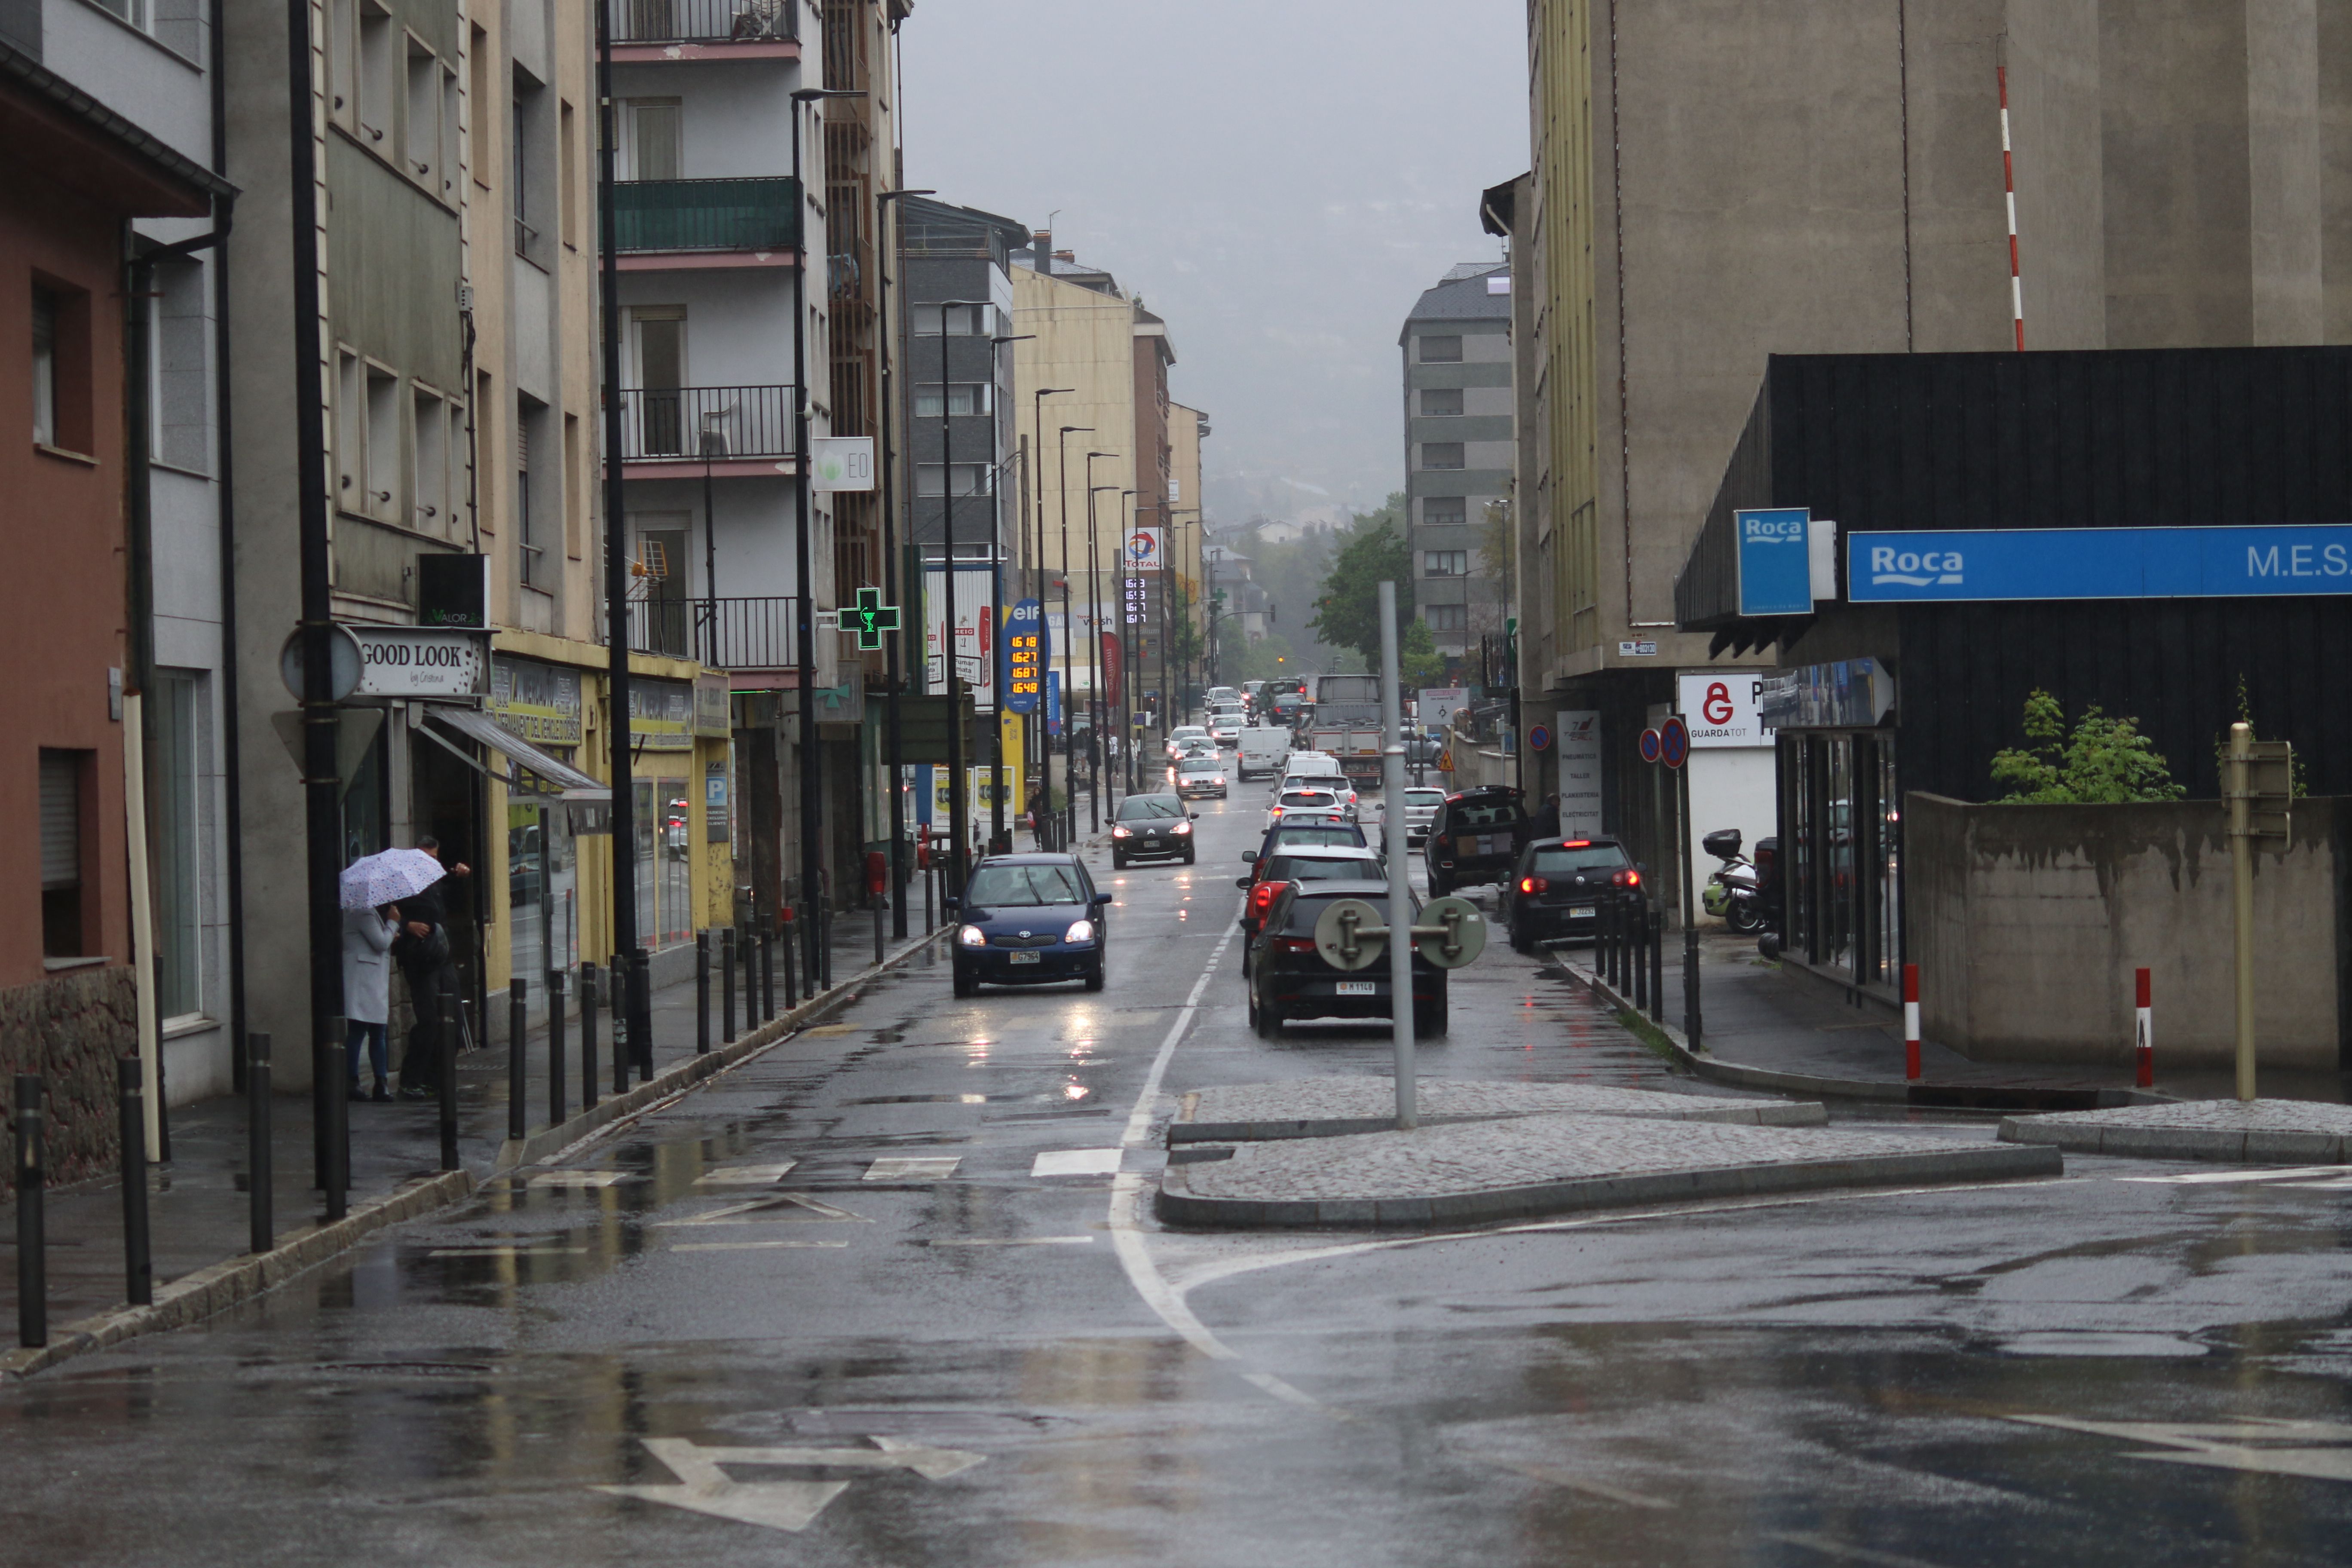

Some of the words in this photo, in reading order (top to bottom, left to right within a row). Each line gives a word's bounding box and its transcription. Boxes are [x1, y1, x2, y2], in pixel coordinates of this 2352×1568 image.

[1746, 519, 1801, 536] Roca
[1871, 547, 1963, 572] Roca
[432, 609, 466, 623] VALOR
[1013, 606, 1039, 620] elf
[362, 643, 410, 665] GOOD
[415, 645, 461, 667] LOOK
[410, 671, 419, 686] by
[420, 671, 444, 683] Cristina
[1691, 728, 1747, 738] GUARDATOT
[1018, 952, 1039, 961] G7964
